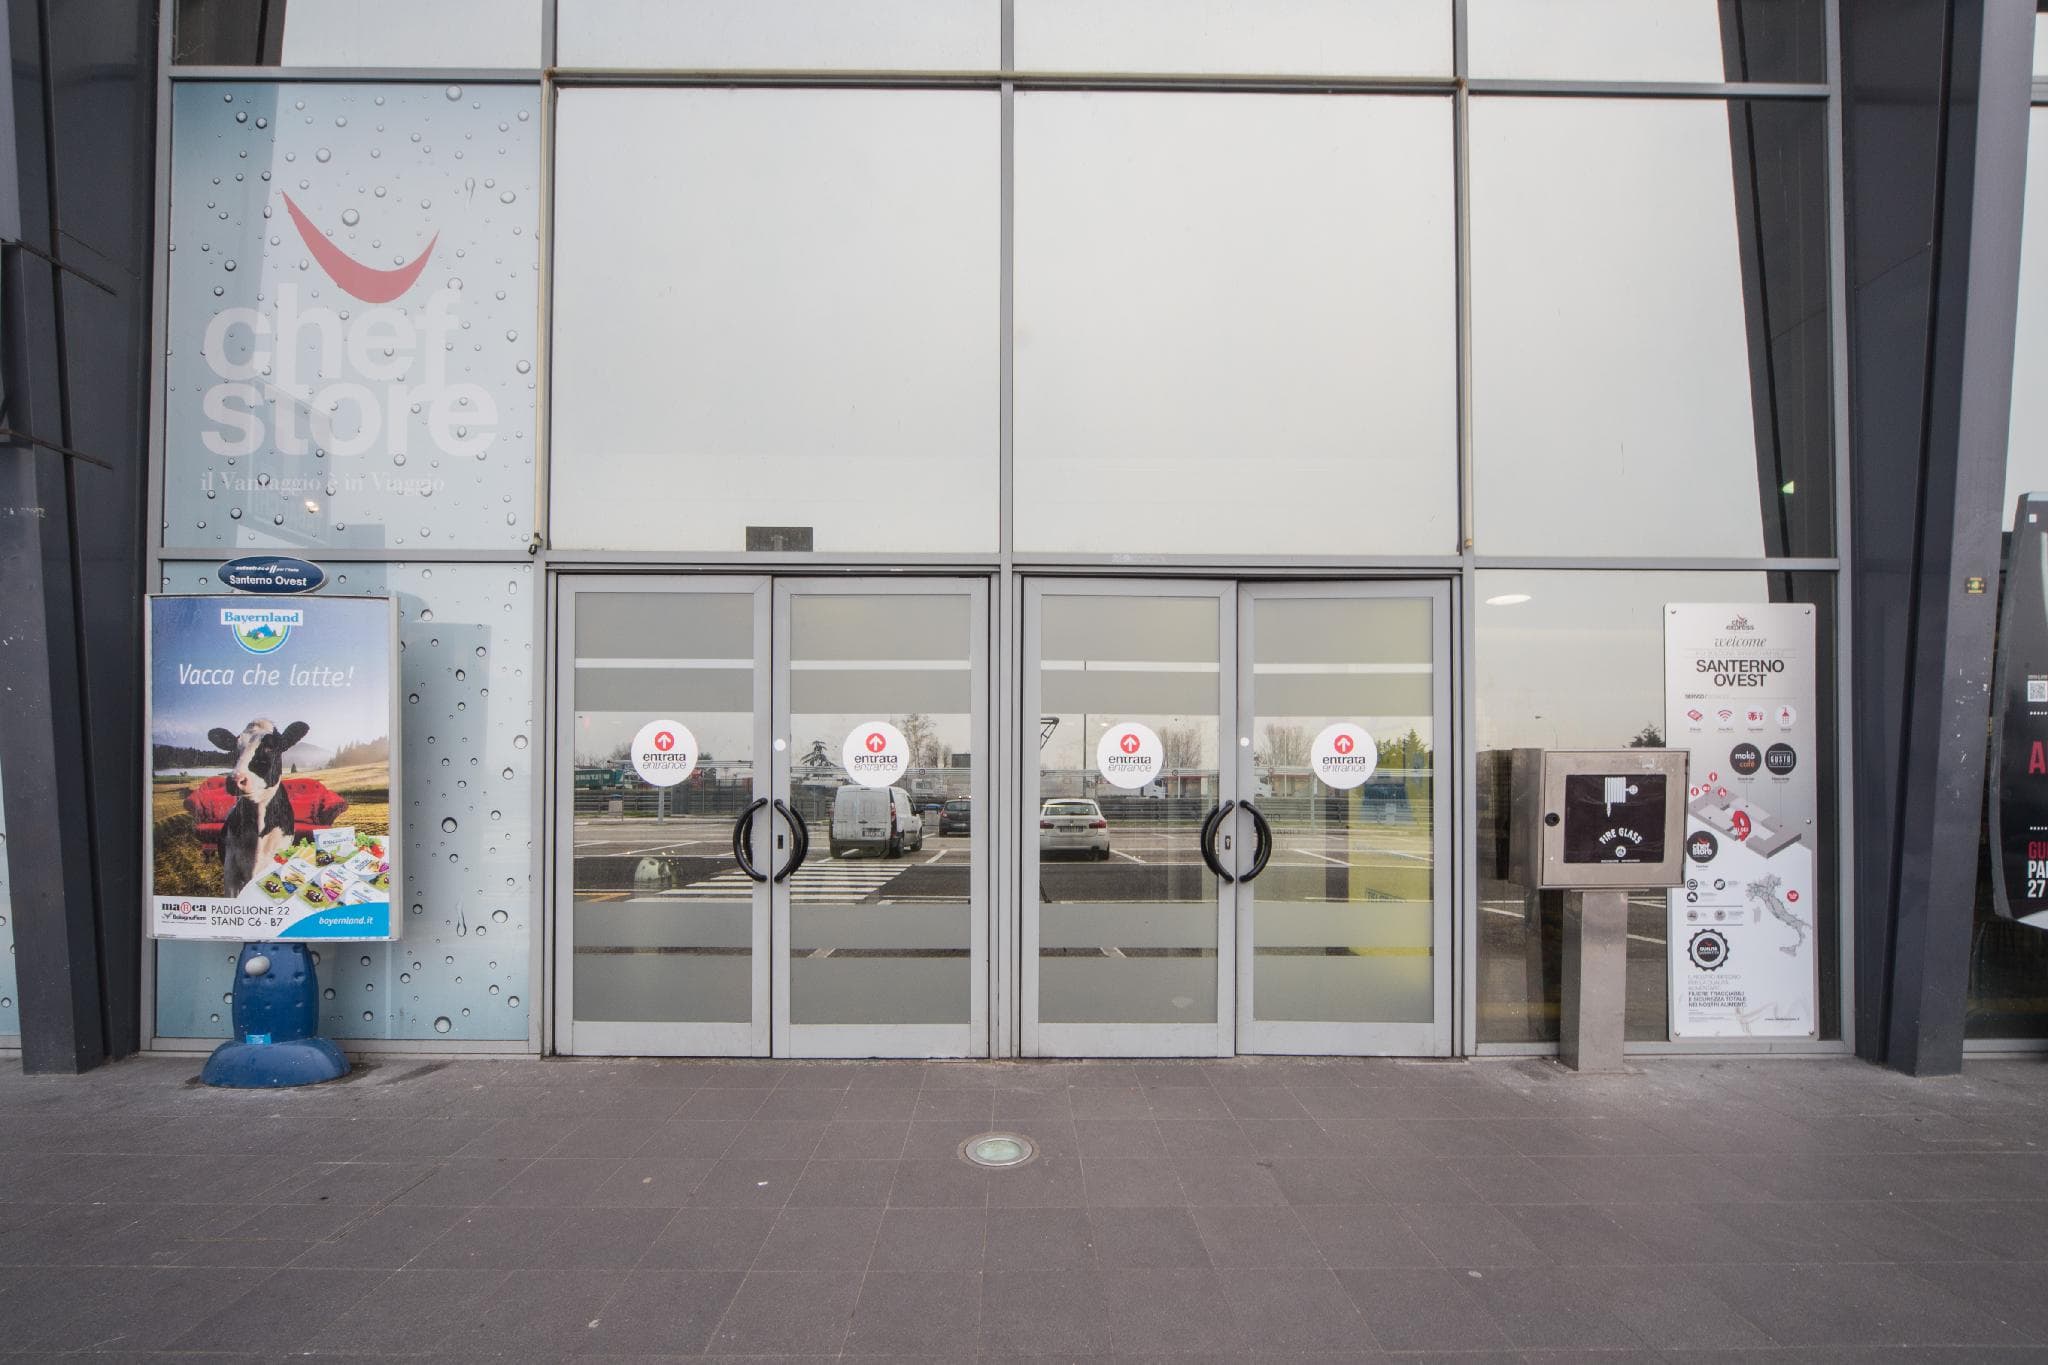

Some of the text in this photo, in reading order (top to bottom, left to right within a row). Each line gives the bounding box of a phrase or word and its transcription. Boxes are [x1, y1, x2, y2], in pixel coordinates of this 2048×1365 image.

[204, 283, 463, 384] chef
[201, 380, 498, 458] store
[201, 473, 213, 492] il
[218, 472, 321, 496] Vantaggio
[343, 473, 370, 492] in
[374, 472, 445, 496] Viaggio
[229, 574, 307, 586] Santerno Ovest
[223, 610, 299, 626] Bayernland
[1714, 635, 1767, 648] welcome
[1696, 659, 1785, 673] SANTERNO
[178, 663, 354, 687] Vacca che latte!
[1714, 673, 1767, 687] OVEST
[642, 752, 686, 762] entrata
[854, 754, 898, 764] entrata
[1108, 754, 1152, 764] entrata
[1322, 754, 1366, 764] entrata
[1770, 755, 1791, 765] GUSTO
[2028, 740, 2048, 774] A
[642, 761, 687, 770] entrance
[854, 763, 898, 772] entrance
[1108, 763, 1152, 772] entrance
[1322, 763, 1366, 773] entrance
[1598, 827, 1643, 845] FIRE GLASS
[2028, 841, 2048, 859] GU
[2027, 879, 2046, 898] 27
[211, 905, 290, 915] PADIGLIONE 22
[211, 917, 245, 926] STAND
[248, 917, 261, 927] C6
[270, 917, 283, 927] B7
[318, 916, 373, 927] bayernland.it
